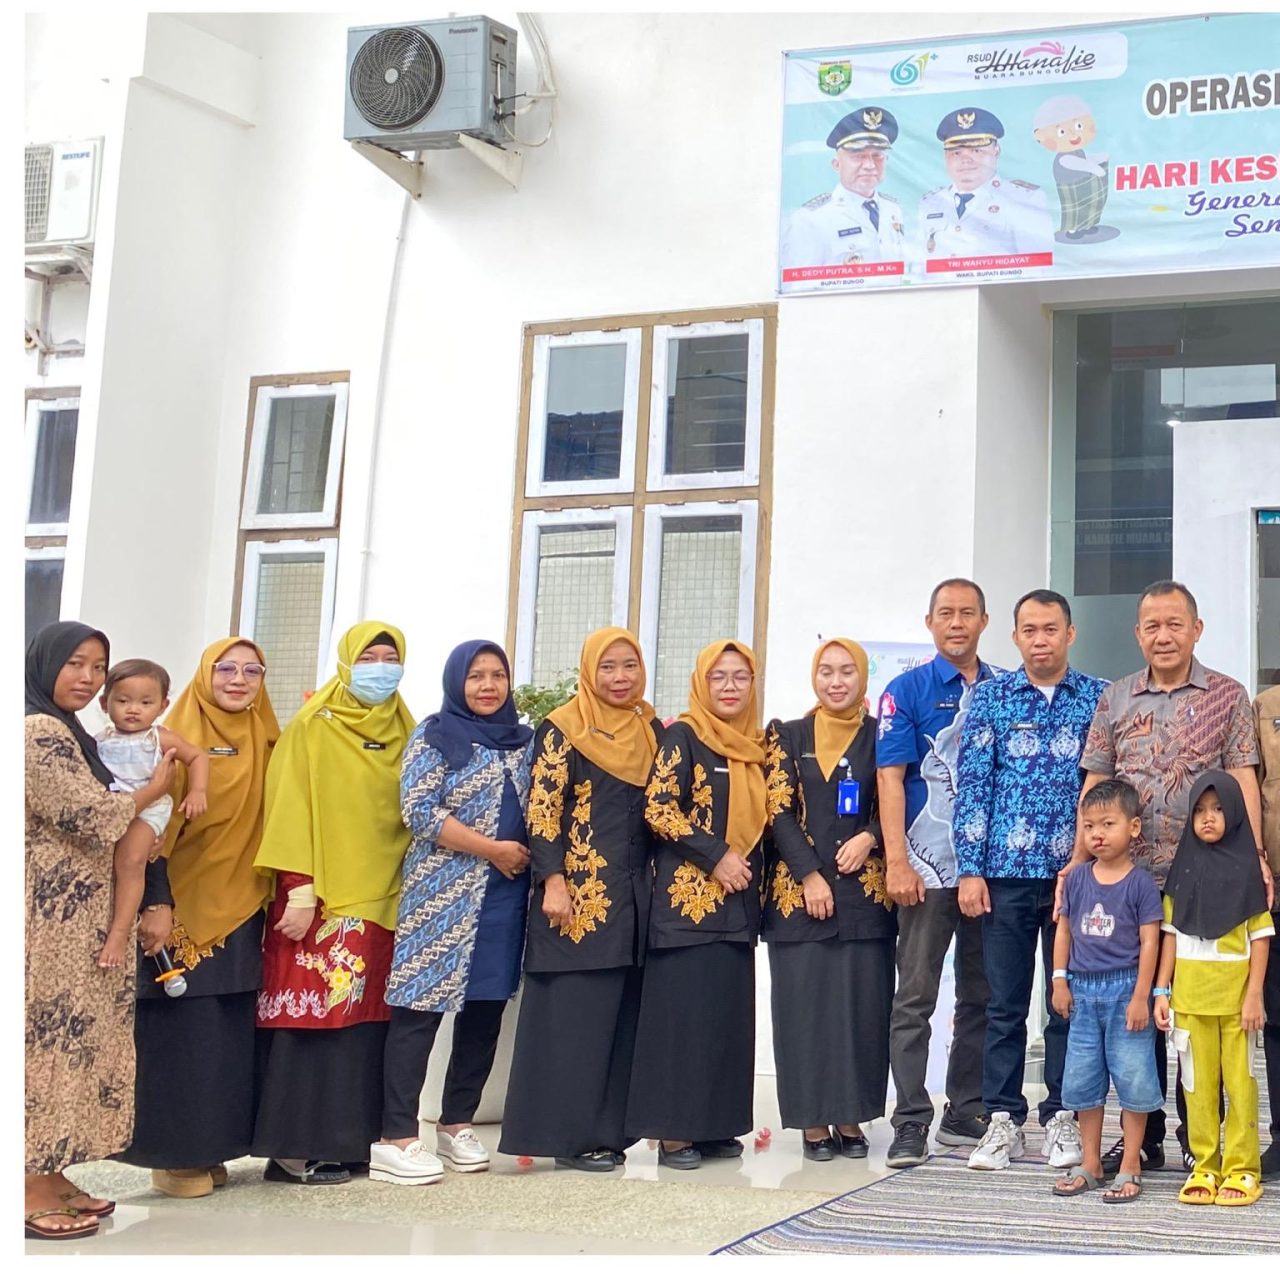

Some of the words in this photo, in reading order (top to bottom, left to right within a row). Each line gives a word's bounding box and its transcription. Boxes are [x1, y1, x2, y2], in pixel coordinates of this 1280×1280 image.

[966, 53, 991, 64] RSUD
[1116, 162, 1199, 191] HARI
[961, 259, 993, 267] WAHYU
[995, 257, 1030, 265] HIDAYAT
[802, 269, 825, 277] DEDY
